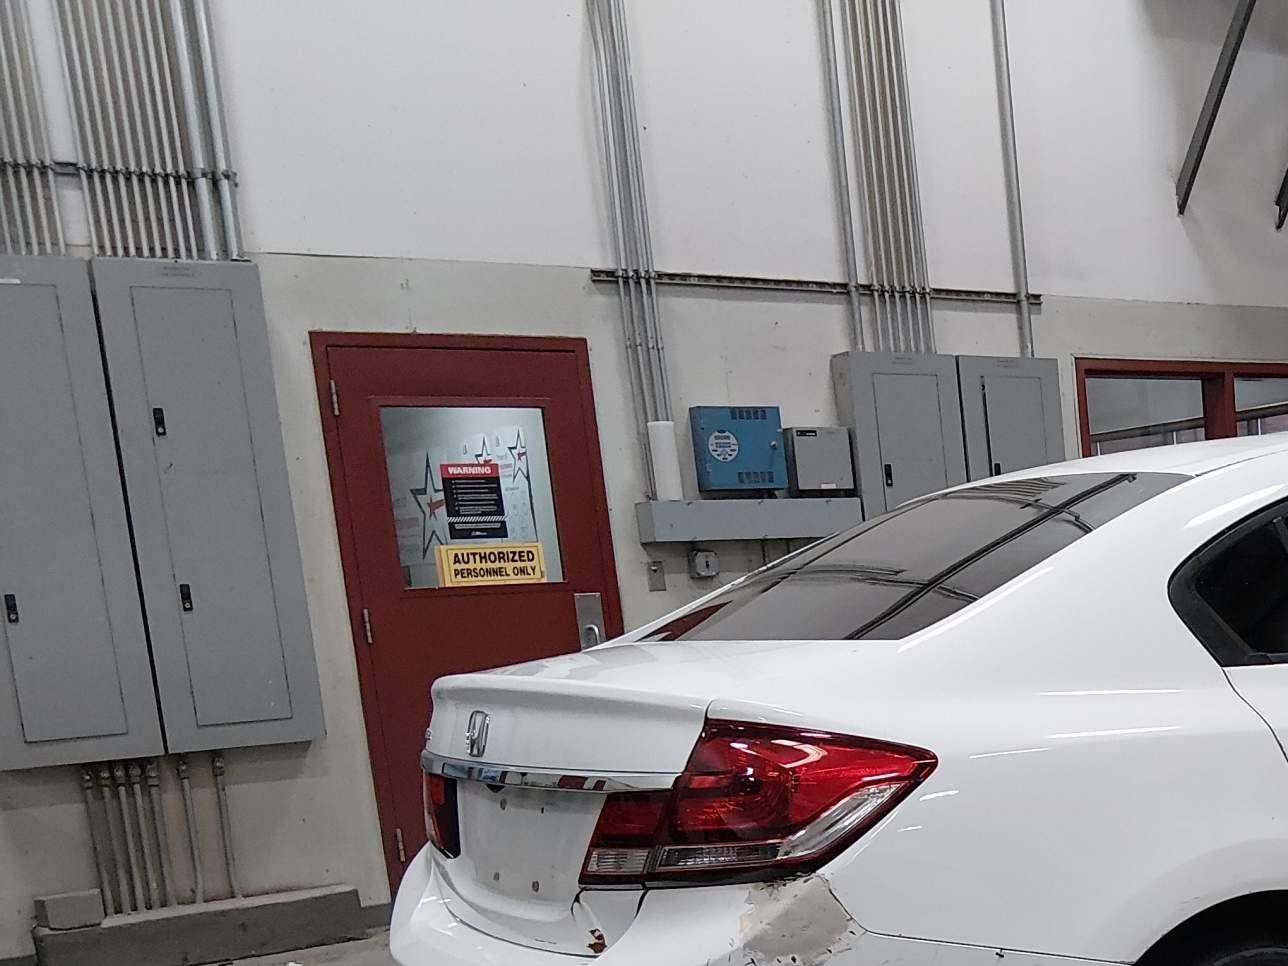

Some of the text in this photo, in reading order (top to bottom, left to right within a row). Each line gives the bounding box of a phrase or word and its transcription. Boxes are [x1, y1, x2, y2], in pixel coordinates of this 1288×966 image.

[447, 466, 492, 475] WARNING
[453, 550, 535, 565] AUTHORIZED
[453, 565, 537, 579] PERSONNEL ONLY
